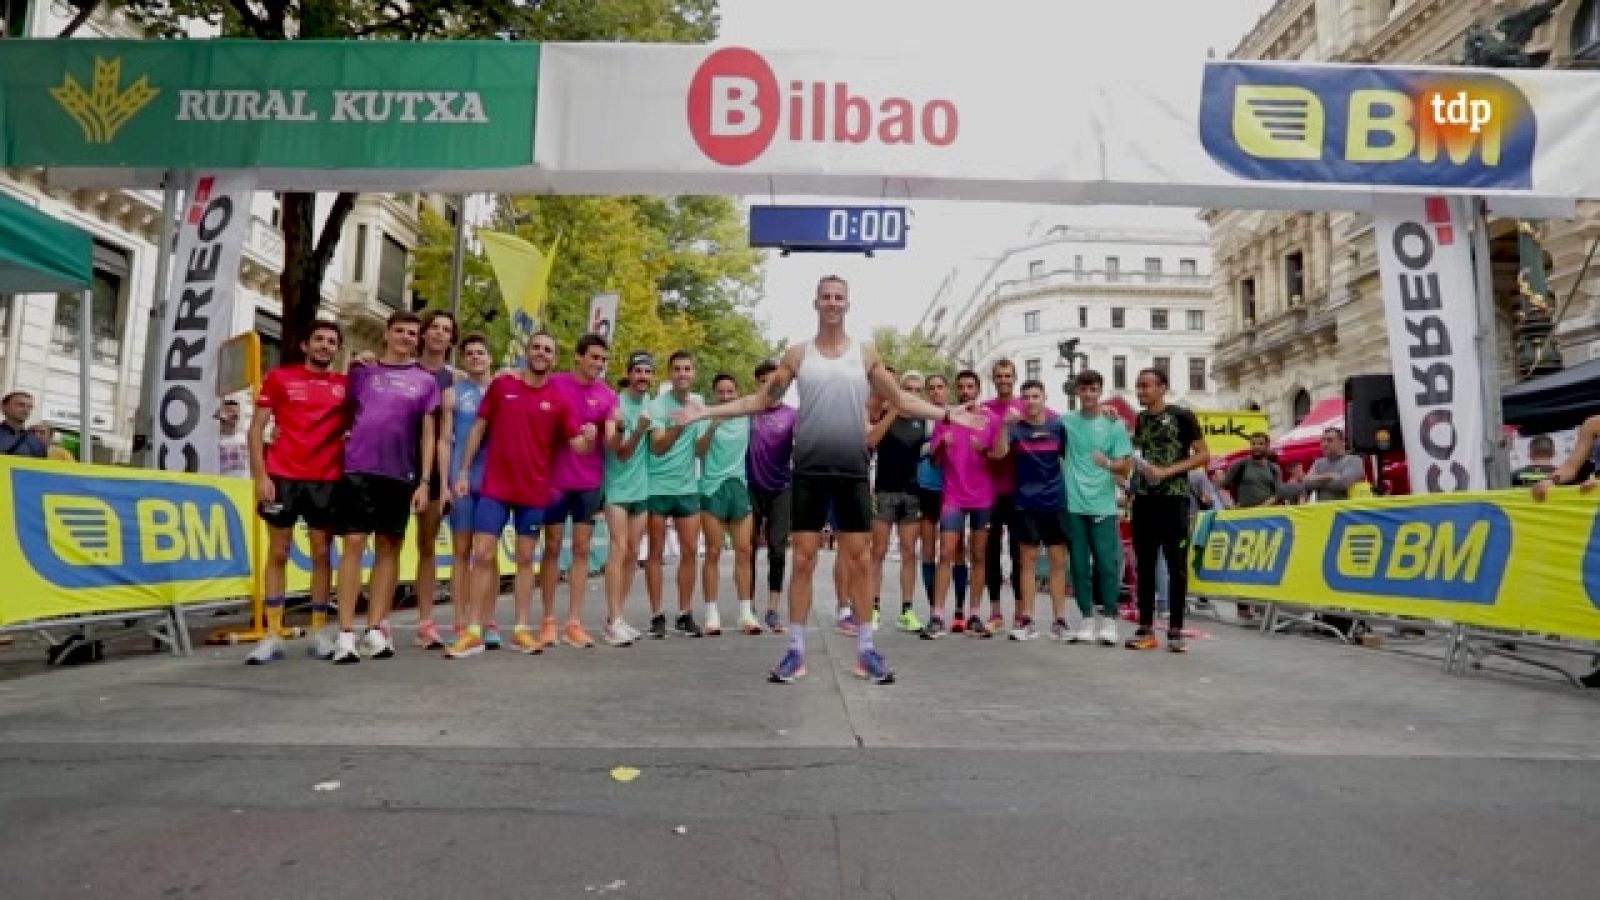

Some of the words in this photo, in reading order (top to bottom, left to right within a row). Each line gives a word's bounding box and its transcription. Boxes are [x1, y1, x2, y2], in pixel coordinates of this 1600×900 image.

[177, 88, 317, 122] RURAL
[330, 90, 490, 122] KUTXA
[709, 75, 960, 146] Bilbao
[1346, 88, 1501, 167] BM
[828, 208, 902, 242] 0:00
[158, 194, 234, 472] CORREO
[137, 498, 232, 562] BM
[1230, 528, 1286, 571] BM
[1385, 521, 1492, 582] BM
